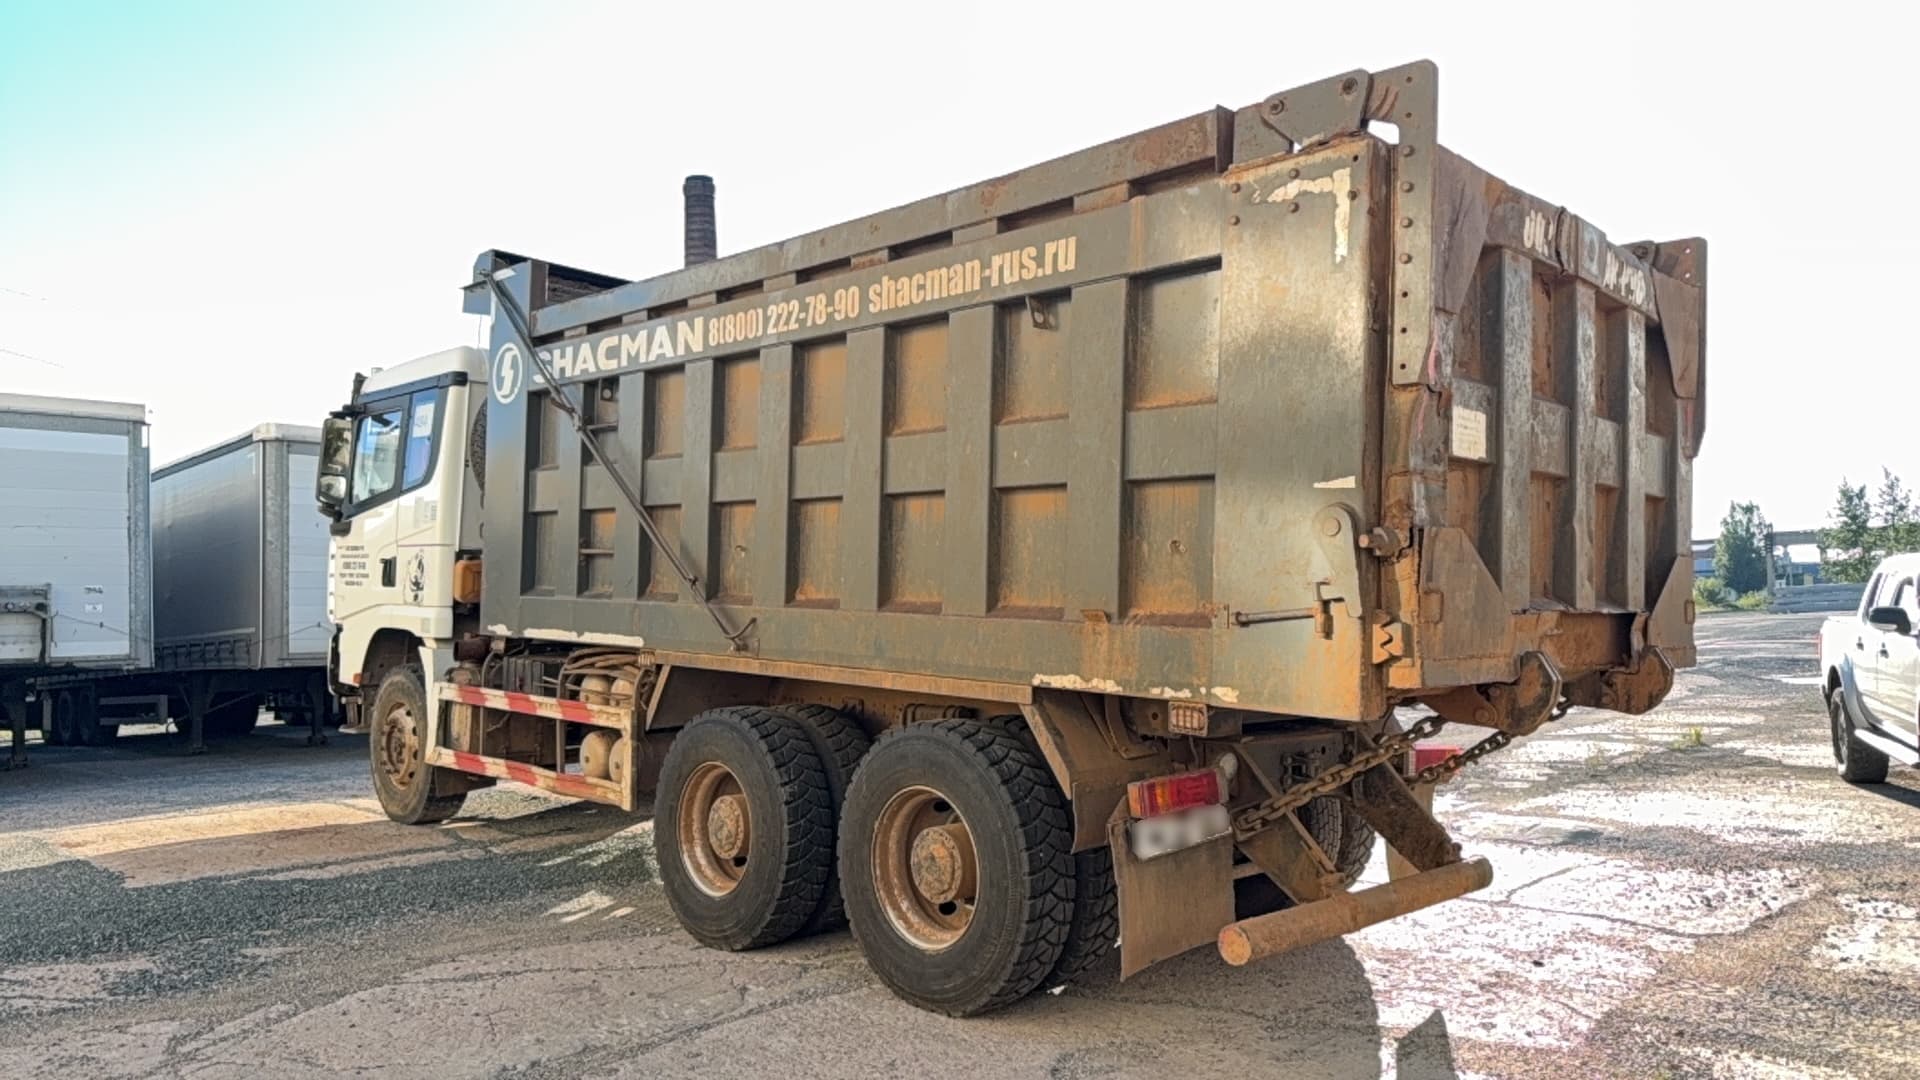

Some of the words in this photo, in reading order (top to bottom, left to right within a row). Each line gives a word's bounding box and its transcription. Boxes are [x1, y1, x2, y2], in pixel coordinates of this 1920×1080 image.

[708, 307, 764, 346] 8(800)
[767, 286, 860, 335] 222-78-90
[868, 236, 1077, 314] shacman-rus.ru
